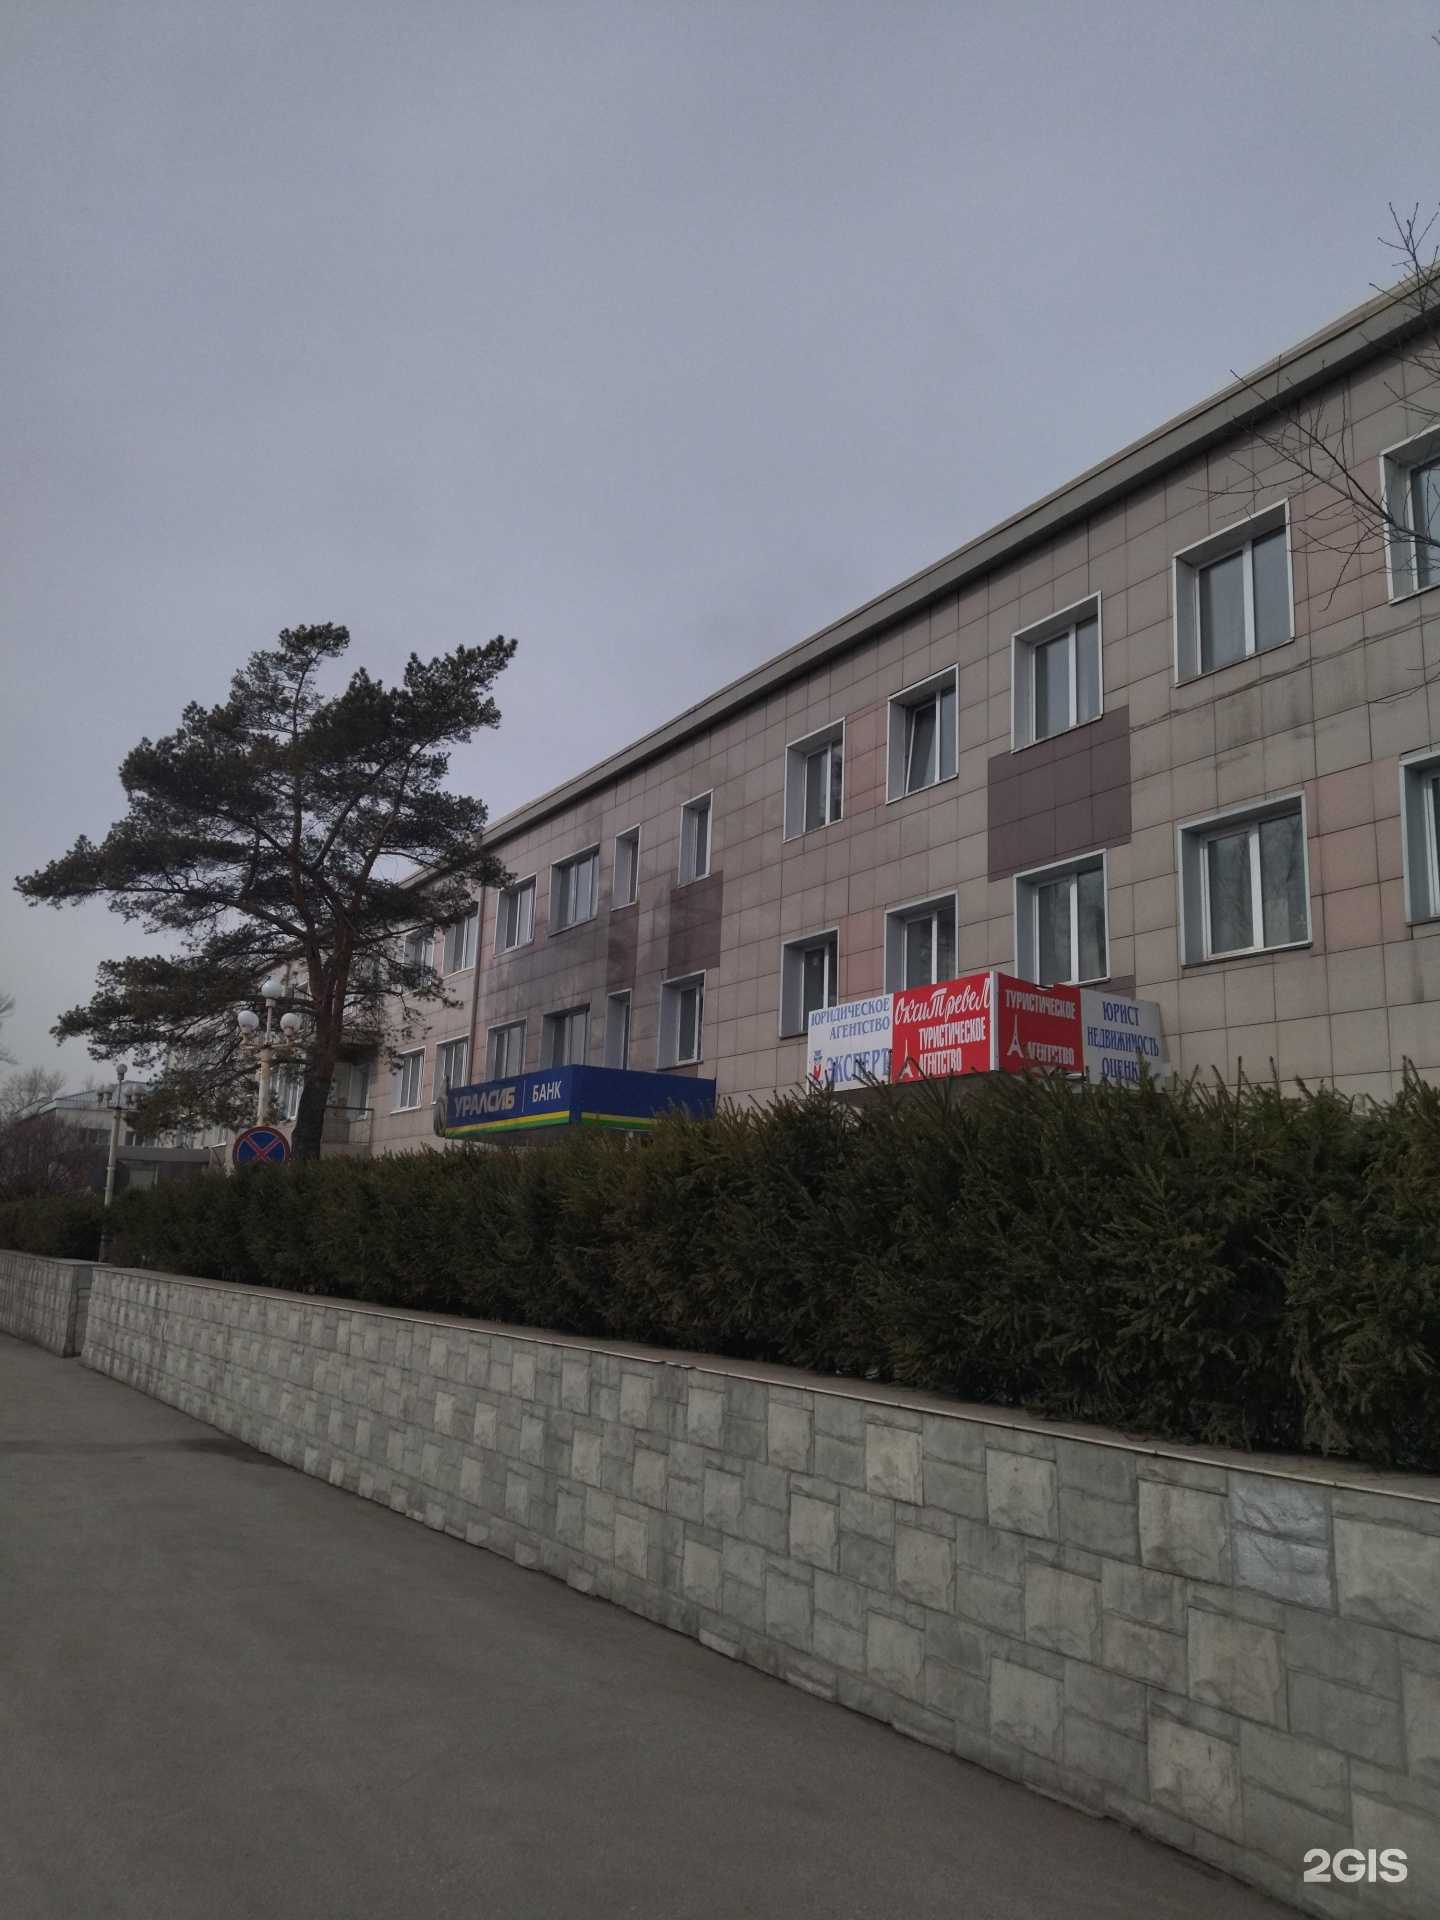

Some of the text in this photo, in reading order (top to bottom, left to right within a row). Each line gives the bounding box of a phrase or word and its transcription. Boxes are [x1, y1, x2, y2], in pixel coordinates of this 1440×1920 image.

[811, 998, 890, 1026] ЮРИДИЧЕСКОЕ
[1006, 990, 1076, 1020] ТУРИСТИЧЕСКОЕ
[1103, 1001, 1139, 1026] ЮРИСТ
[829, 1016, 890, 1040] АГЕНТСТВО
[918, 1016, 986, 1051] ТУРИСТИЧЕСКОЕ
[1087, 1026, 1159, 1057] НЕДВИЖИМОСТЬ
[827, 1048, 889, 1083] ЭКСПЕРТ
[918, 1047, 962, 1077] АГЕНТСТВО
[1102, 1056, 1143, 1084] ОЦЕНК
[454, 1080, 562, 1117] УРАЛСИБ БАНК
